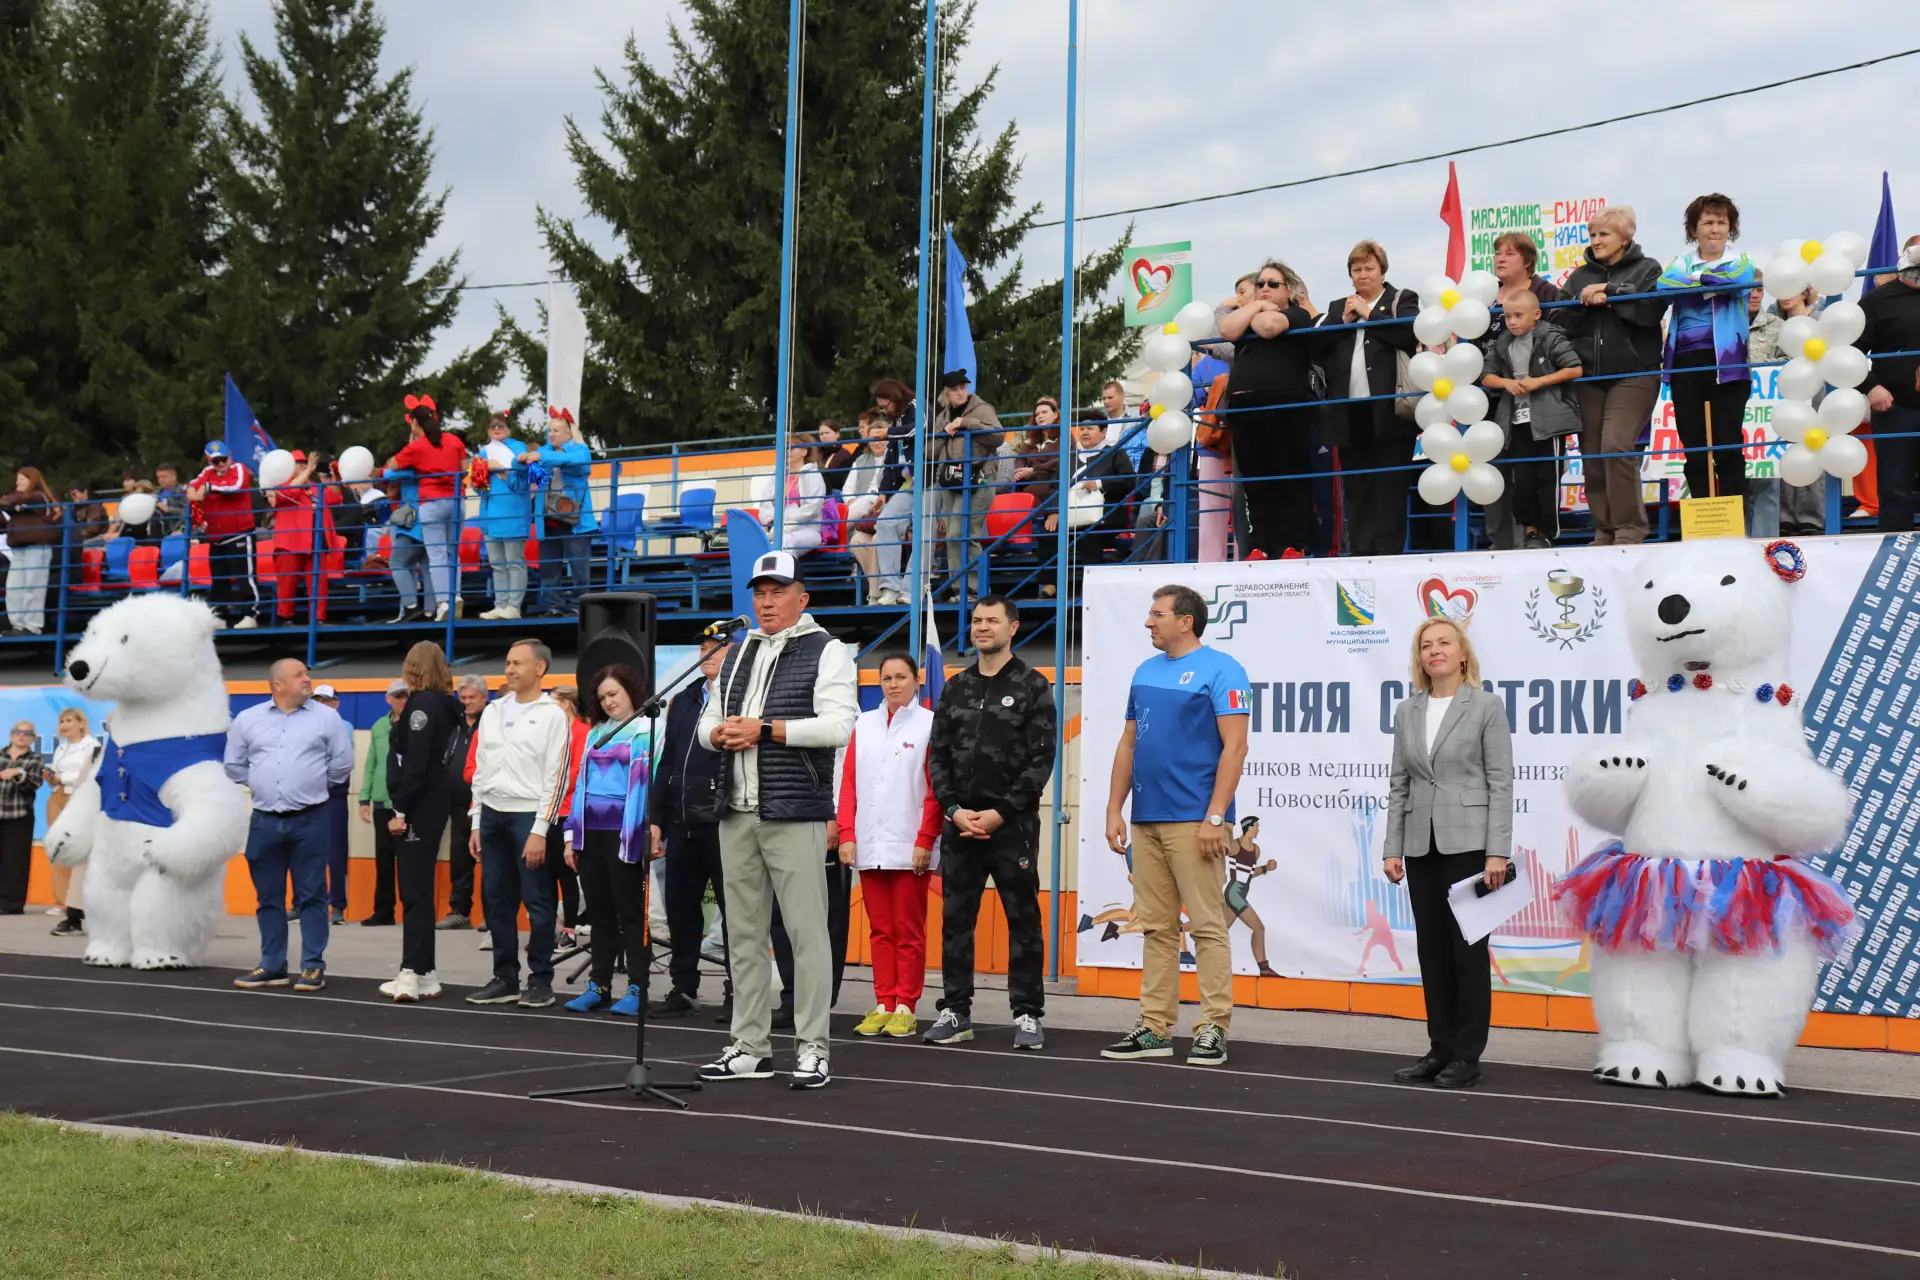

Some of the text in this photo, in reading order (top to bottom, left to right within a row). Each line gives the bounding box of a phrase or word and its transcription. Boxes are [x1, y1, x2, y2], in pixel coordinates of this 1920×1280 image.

[1554, 224, 1590, 247] КЛАС
[1234, 582, 1309, 592] ЗДРАВООХРАНЕНИЕ
[1250, 682, 1350, 733] тняя
[1308, 763, 1391, 780] медици
[1257, 787, 1390, 816] Новосибирс
